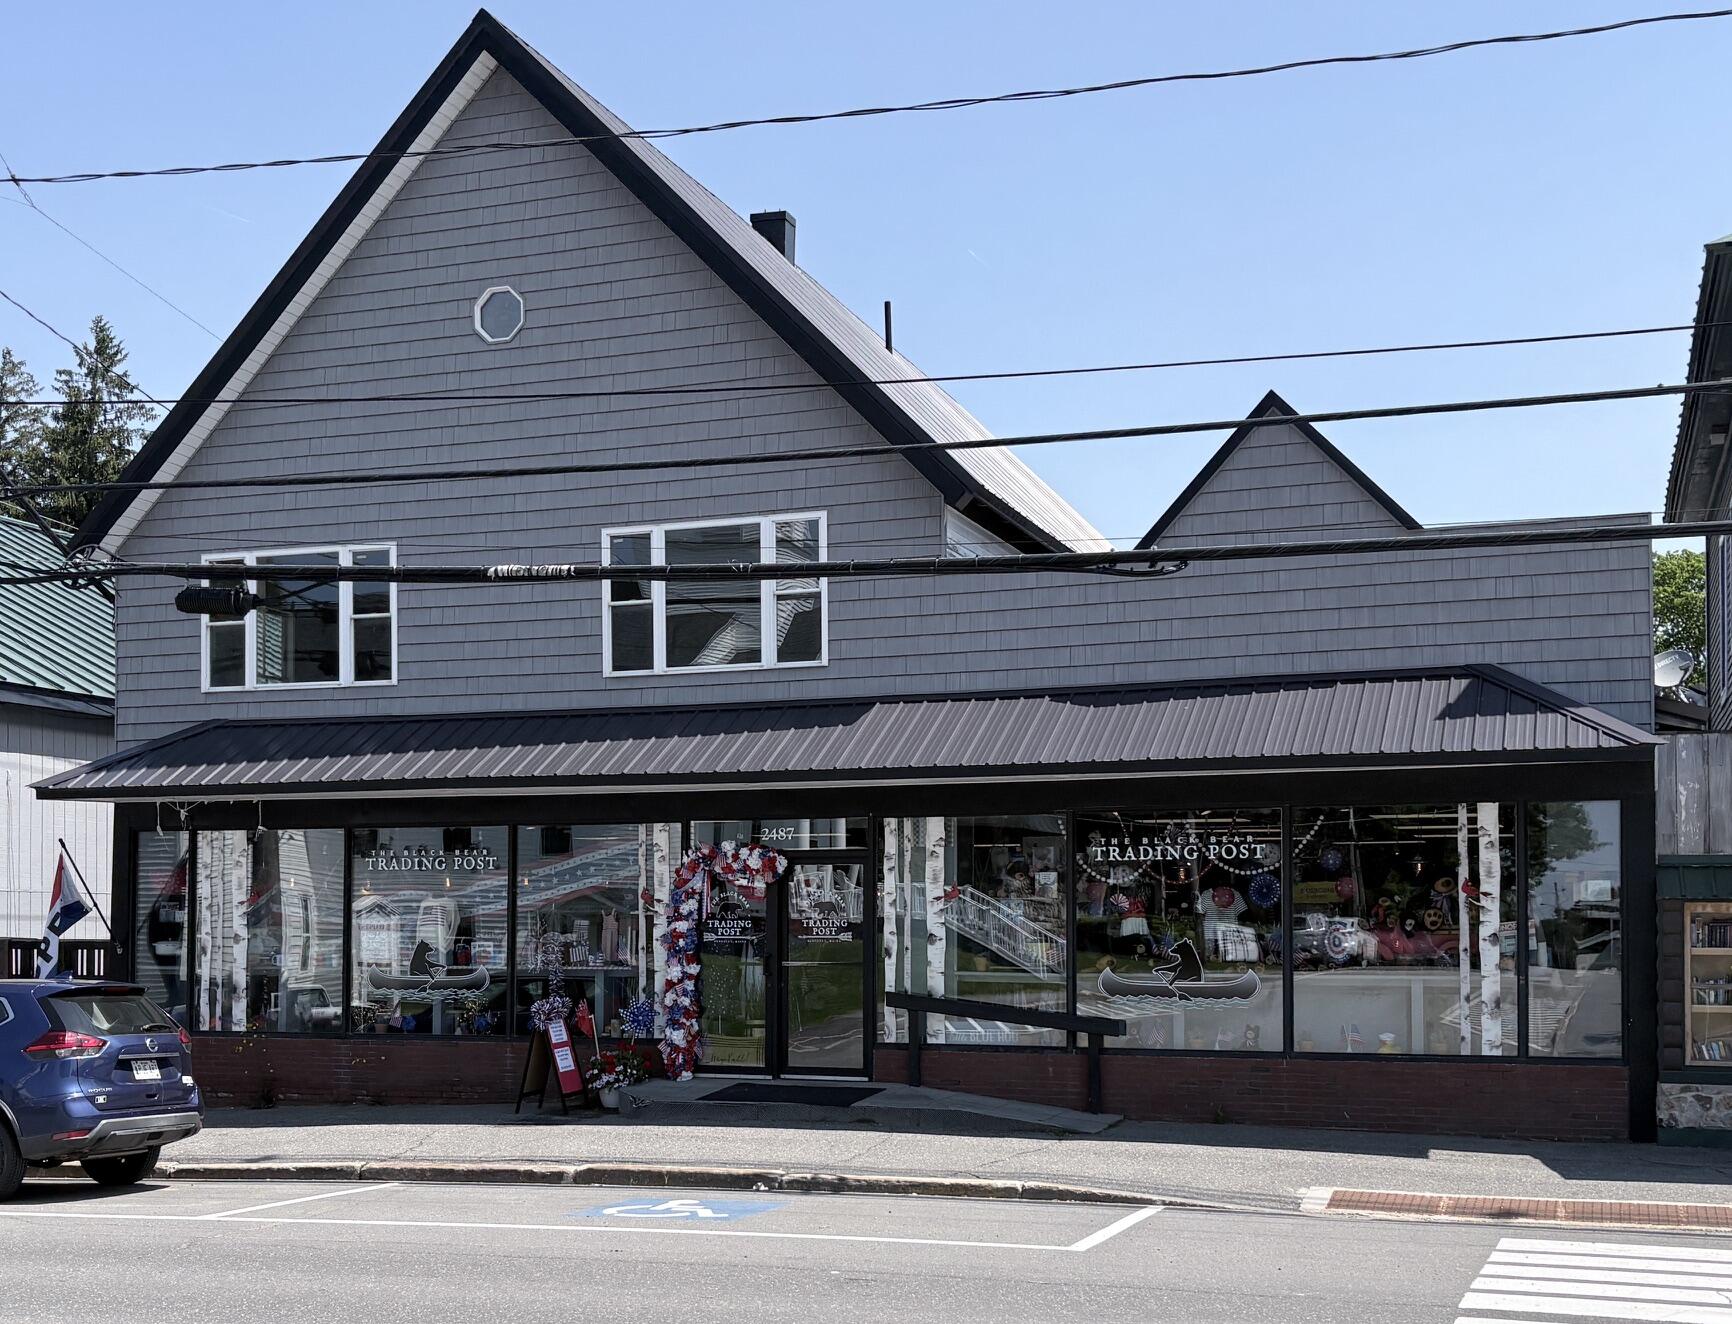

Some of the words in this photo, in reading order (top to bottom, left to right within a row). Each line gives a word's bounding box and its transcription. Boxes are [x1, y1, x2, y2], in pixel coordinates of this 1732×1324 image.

[761, 827, 795, 840] 2487
[1210, 835, 1254, 843] BEAR
[1093, 846, 1199, 861] TRADING
[1208, 844, 1266, 860] POST
[365, 857, 447, 871] TRADING
[453, 856, 498, 870] POST
[707, 920, 752, 928] TRADING
[801, 919, 848, 928] TRADING
[717, 928, 742, 936] POST
[812, 927, 838, 935] POST
